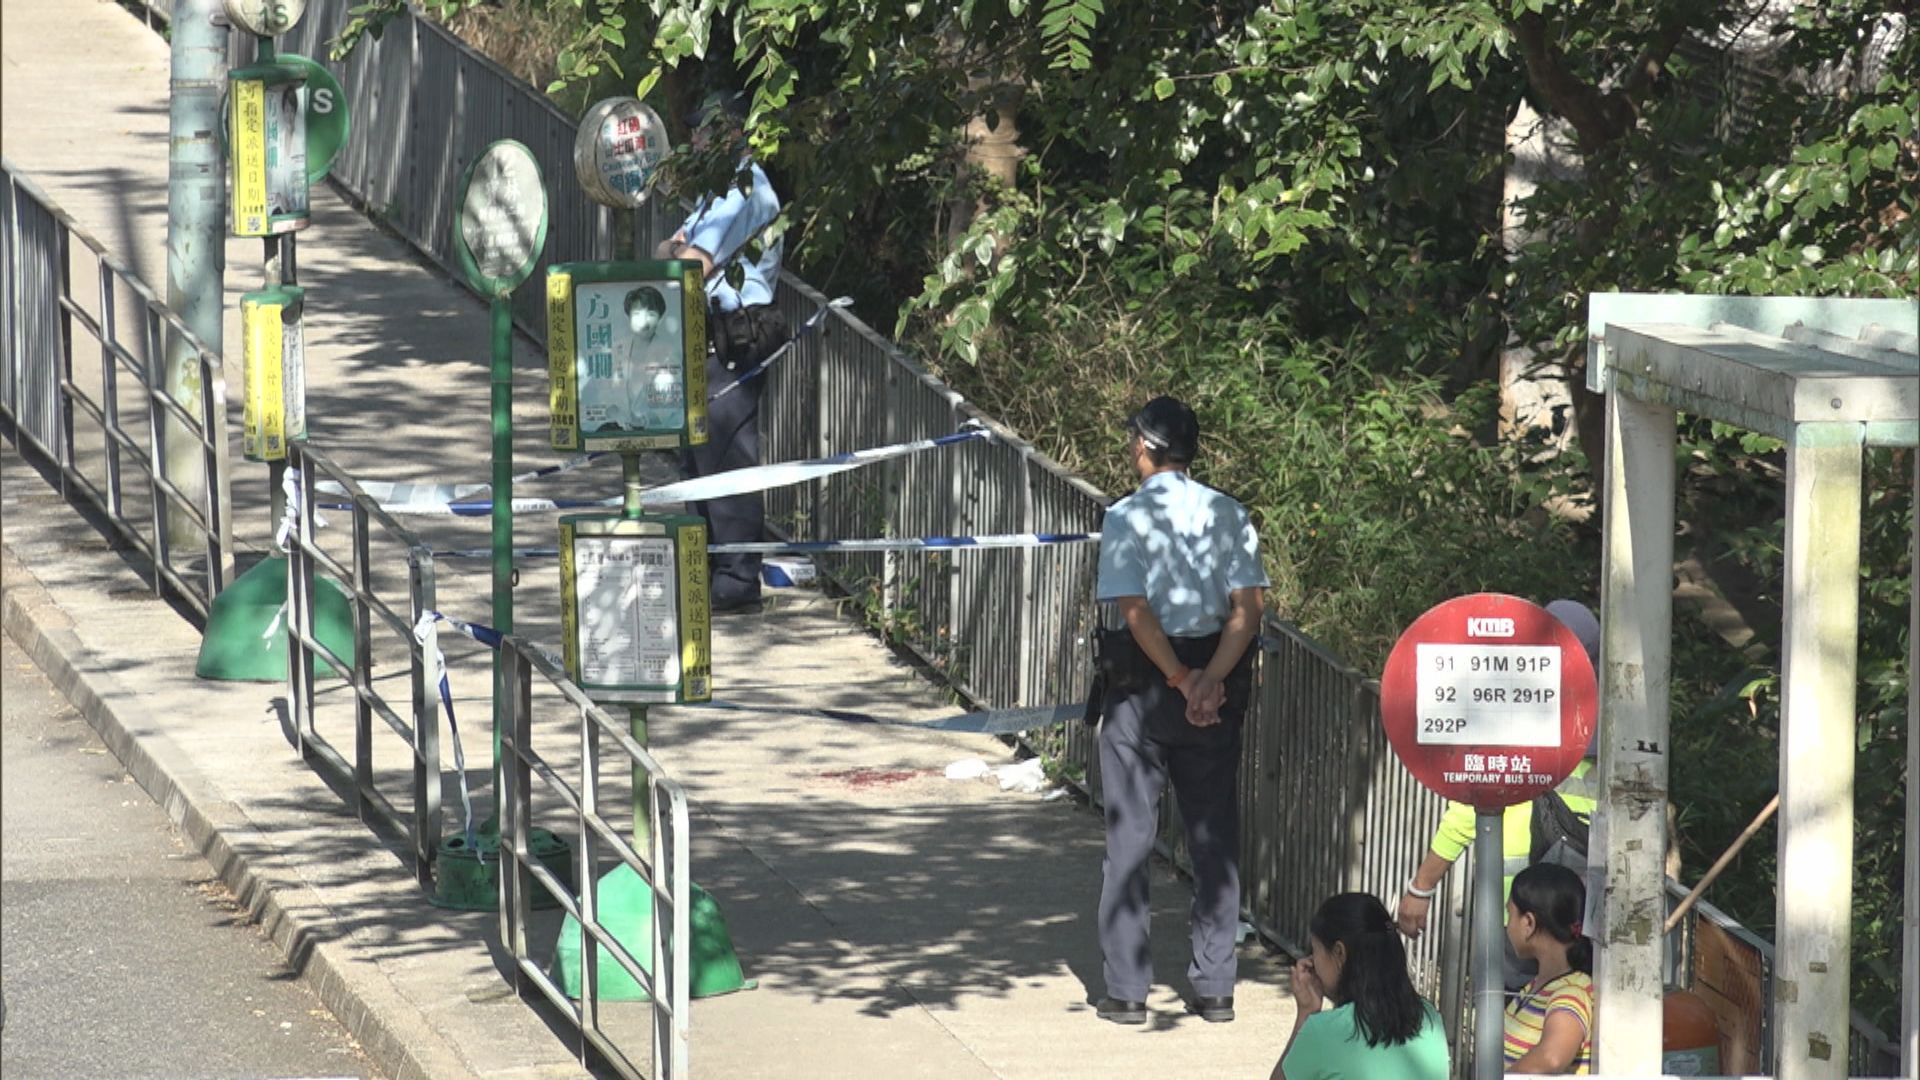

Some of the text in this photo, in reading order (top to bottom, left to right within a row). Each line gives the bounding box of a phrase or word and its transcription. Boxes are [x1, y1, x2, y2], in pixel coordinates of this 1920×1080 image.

[686, 529, 707, 661] 可指定派送日期
[1467, 617, 1515, 637] KMB
[1435, 656, 1551, 672] 91 91M 91P
[1435, 686, 1555, 703] 92 96R 291P
[1424, 718, 1467, 733] 292P
[1464, 754, 1531, 773] 臨時站
[1443, 772, 1553, 784] TEMPORARY BUS STOP
